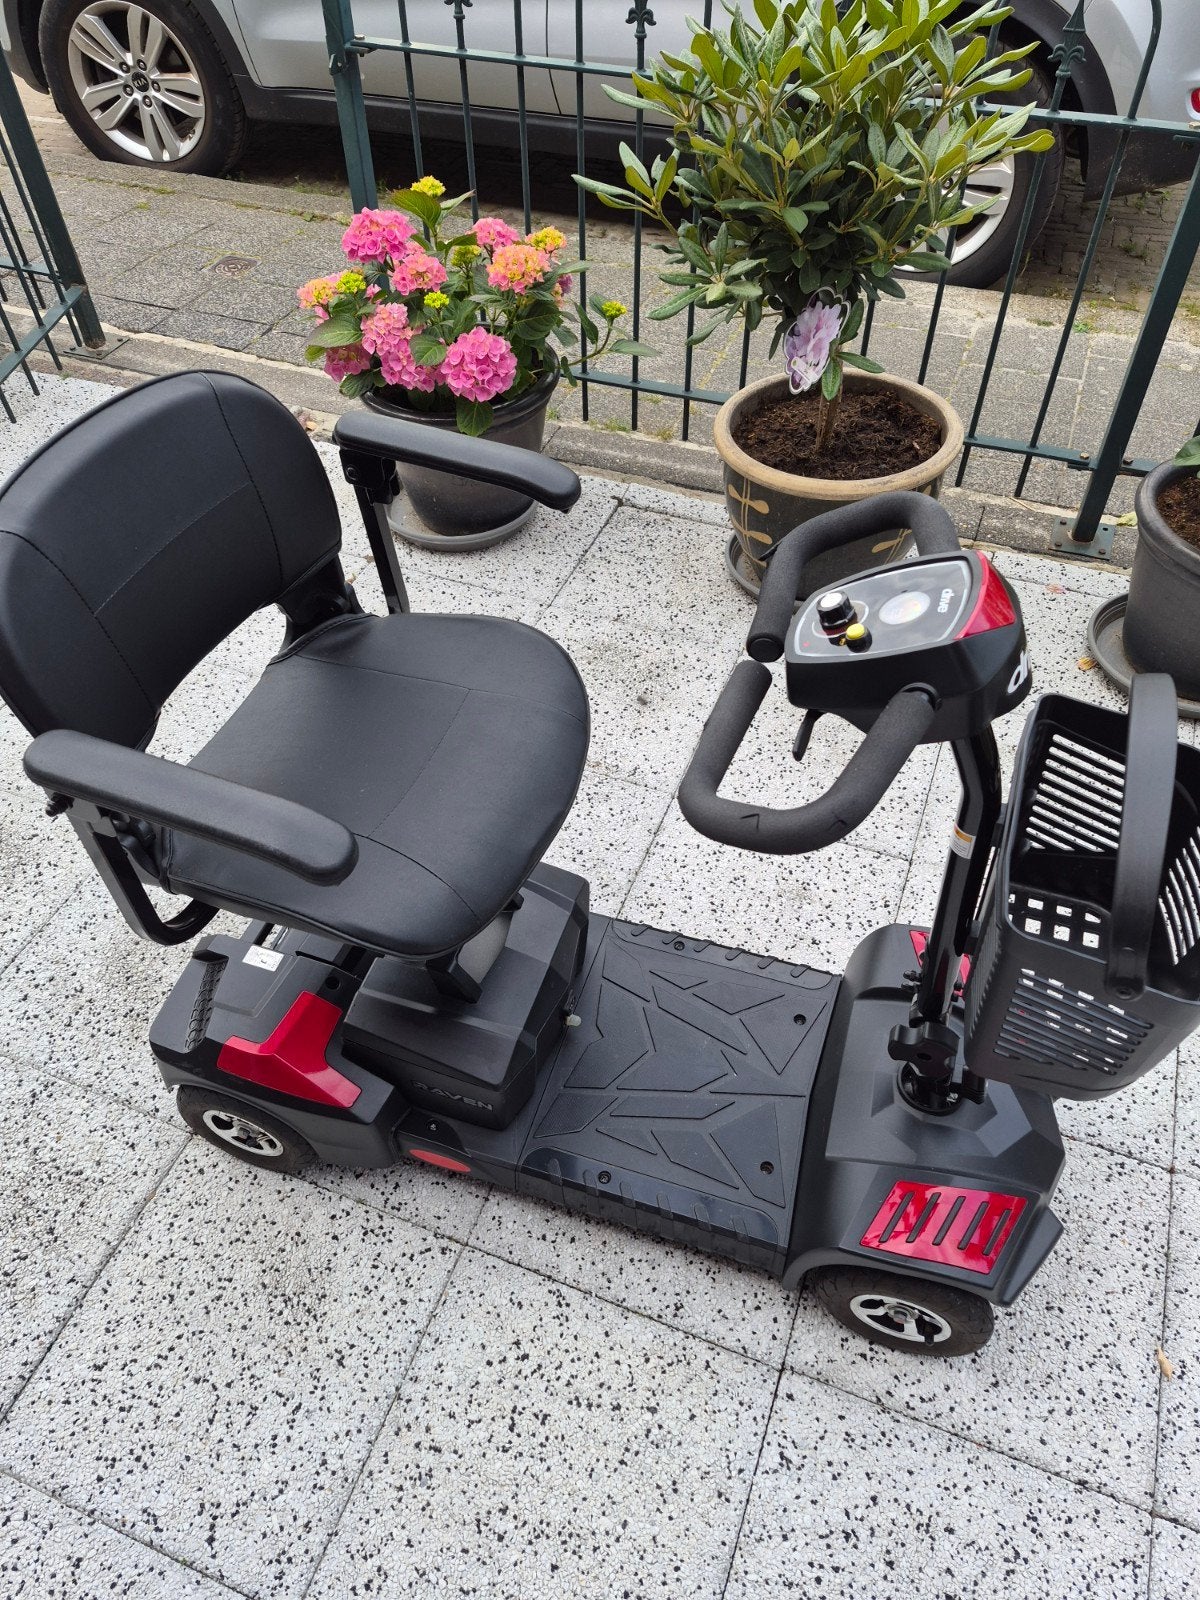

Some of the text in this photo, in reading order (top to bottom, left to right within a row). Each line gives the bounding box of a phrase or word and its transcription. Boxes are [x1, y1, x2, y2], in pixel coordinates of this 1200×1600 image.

[133, 77, 147, 87] KIA
[937, 588, 955, 613] drive
[412, 1081, 493, 1111] RAVEN
